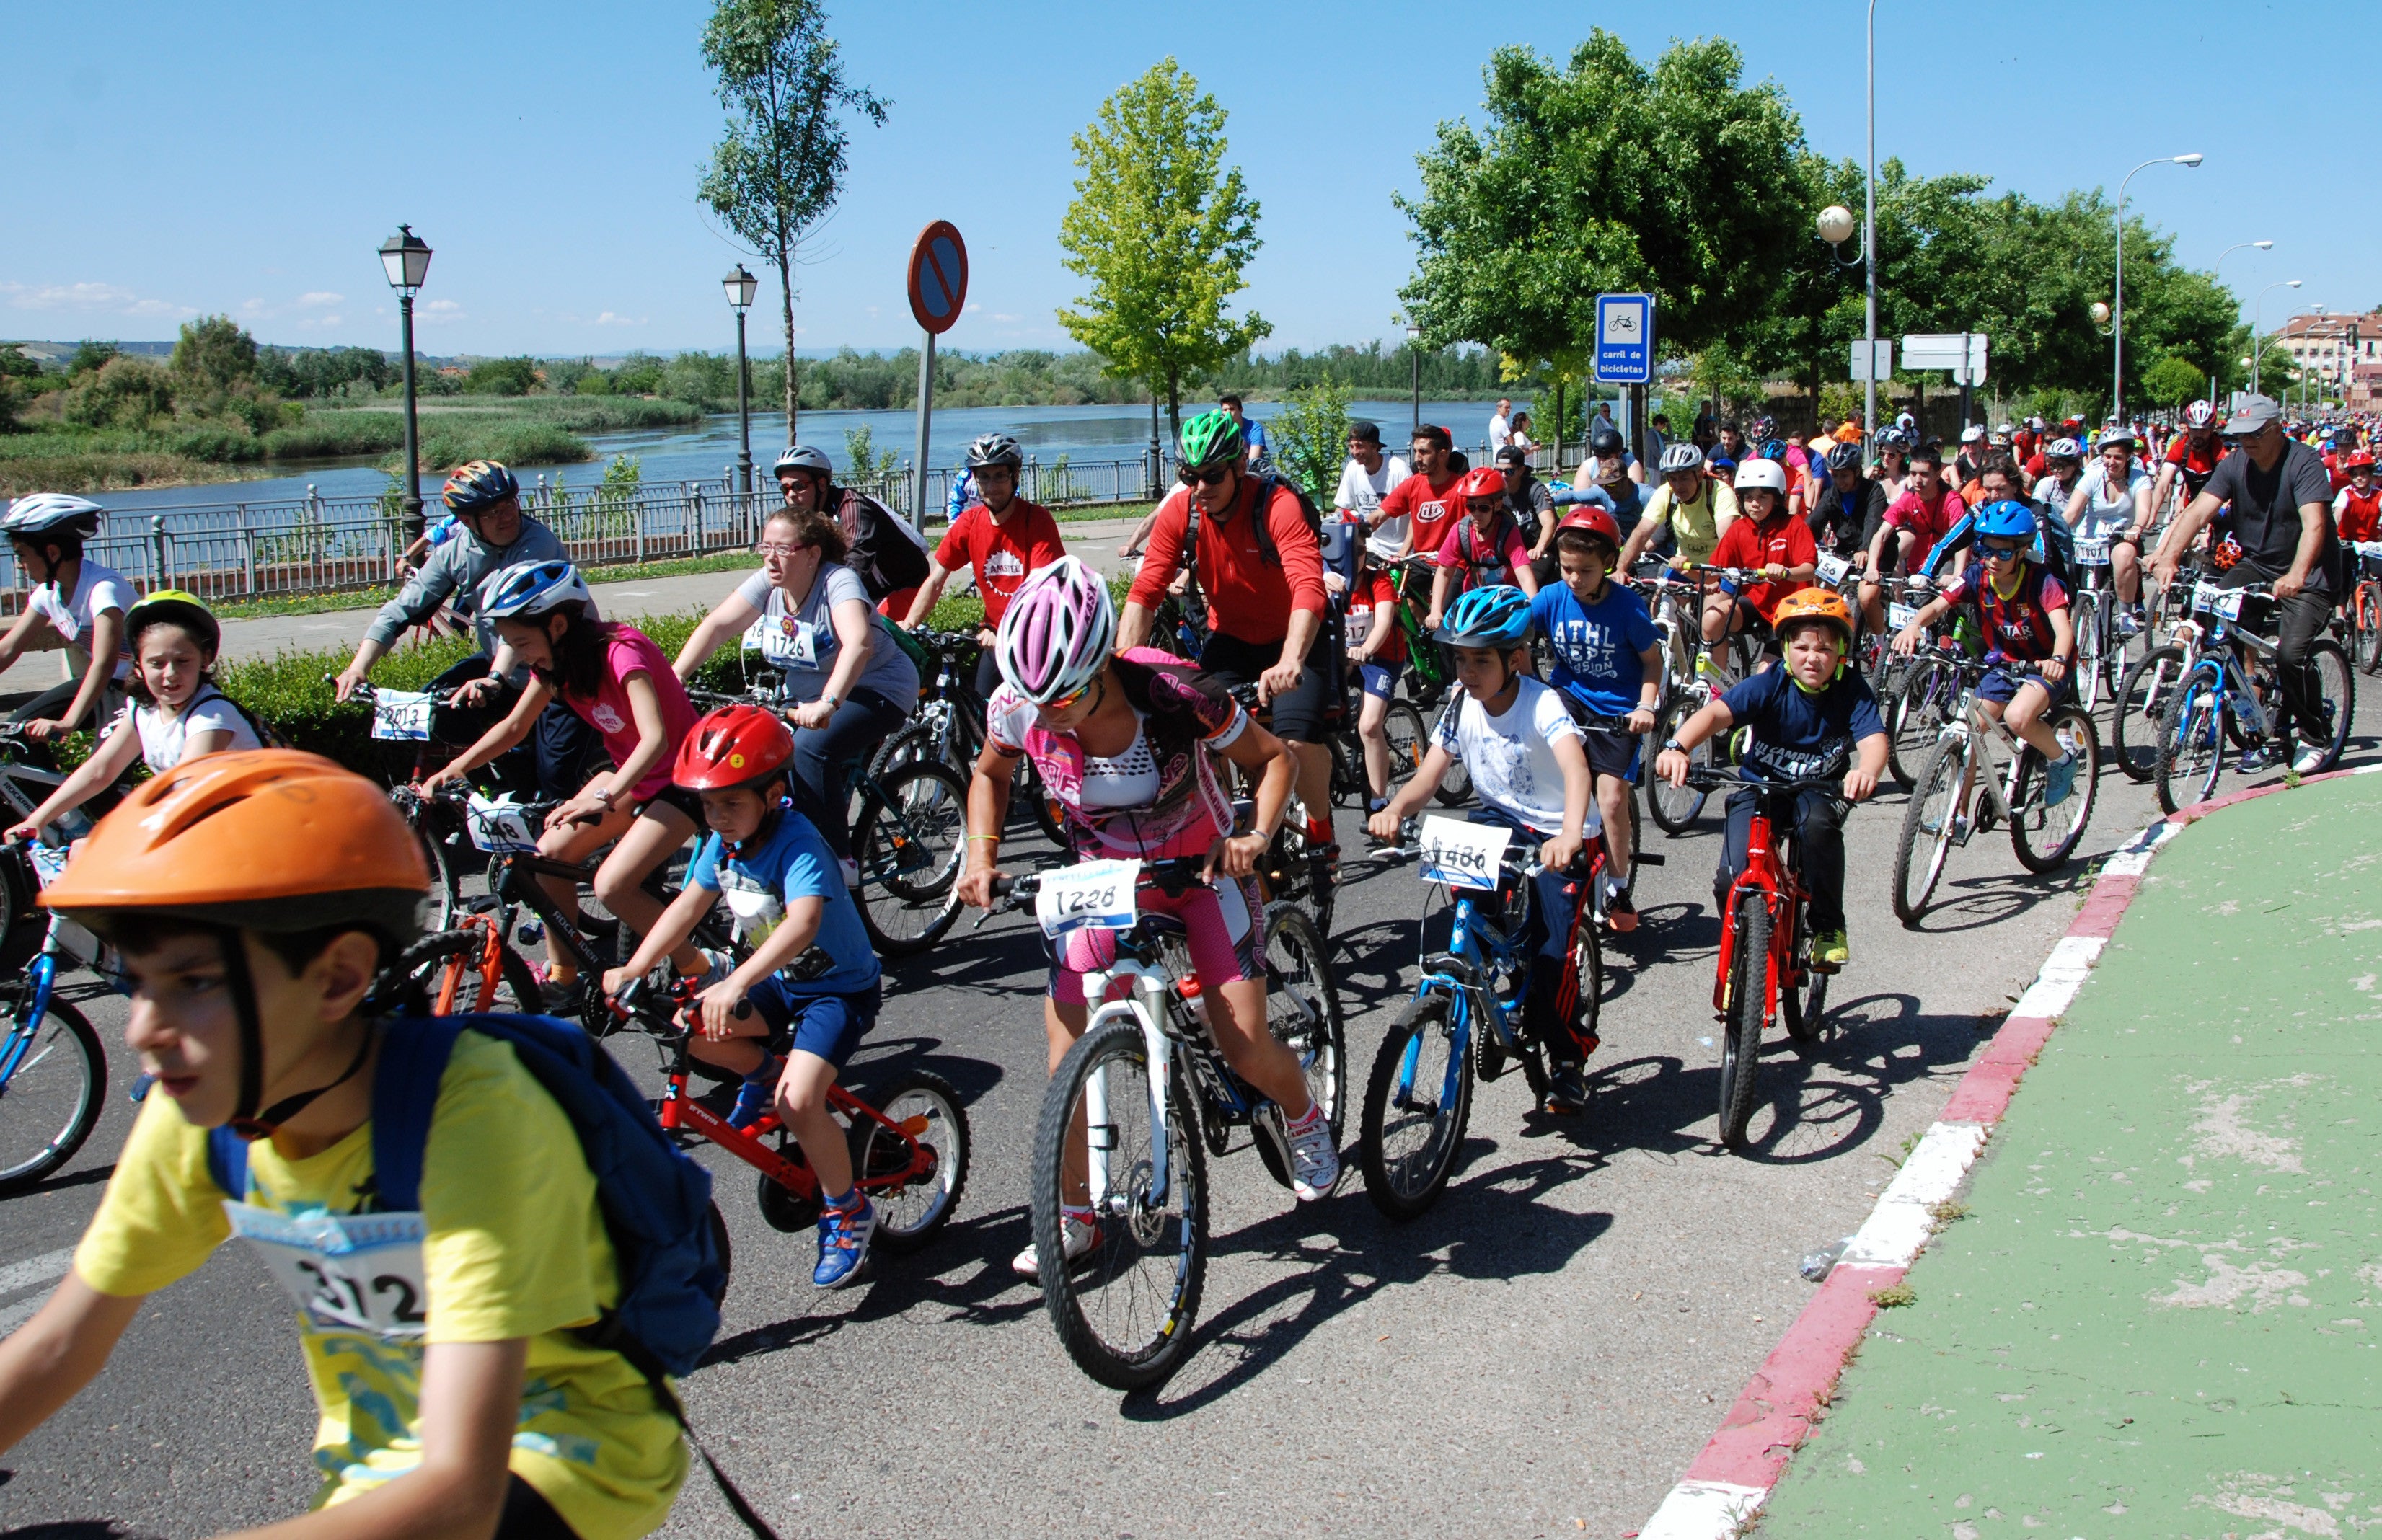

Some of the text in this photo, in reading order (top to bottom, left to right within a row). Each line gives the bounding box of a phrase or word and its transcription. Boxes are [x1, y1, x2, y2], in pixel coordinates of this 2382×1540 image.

[1602, 350, 1641, 359] carril de
[1600, 364, 1644, 373] bicicletas
[1084, 583, 1097, 627] KASK
[2200, 590, 2231, 608] 207
[1553, 620, 1615, 648] ATHL
[772, 635, 804, 657] 1726
[1769, 745, 1823, 766] CAMPUS
[1056, 885, 1116, 916] 1228
[552, 910, 599, 964] ROCKRIDER
[1292, 1126, 1314, 1138] LUCK
